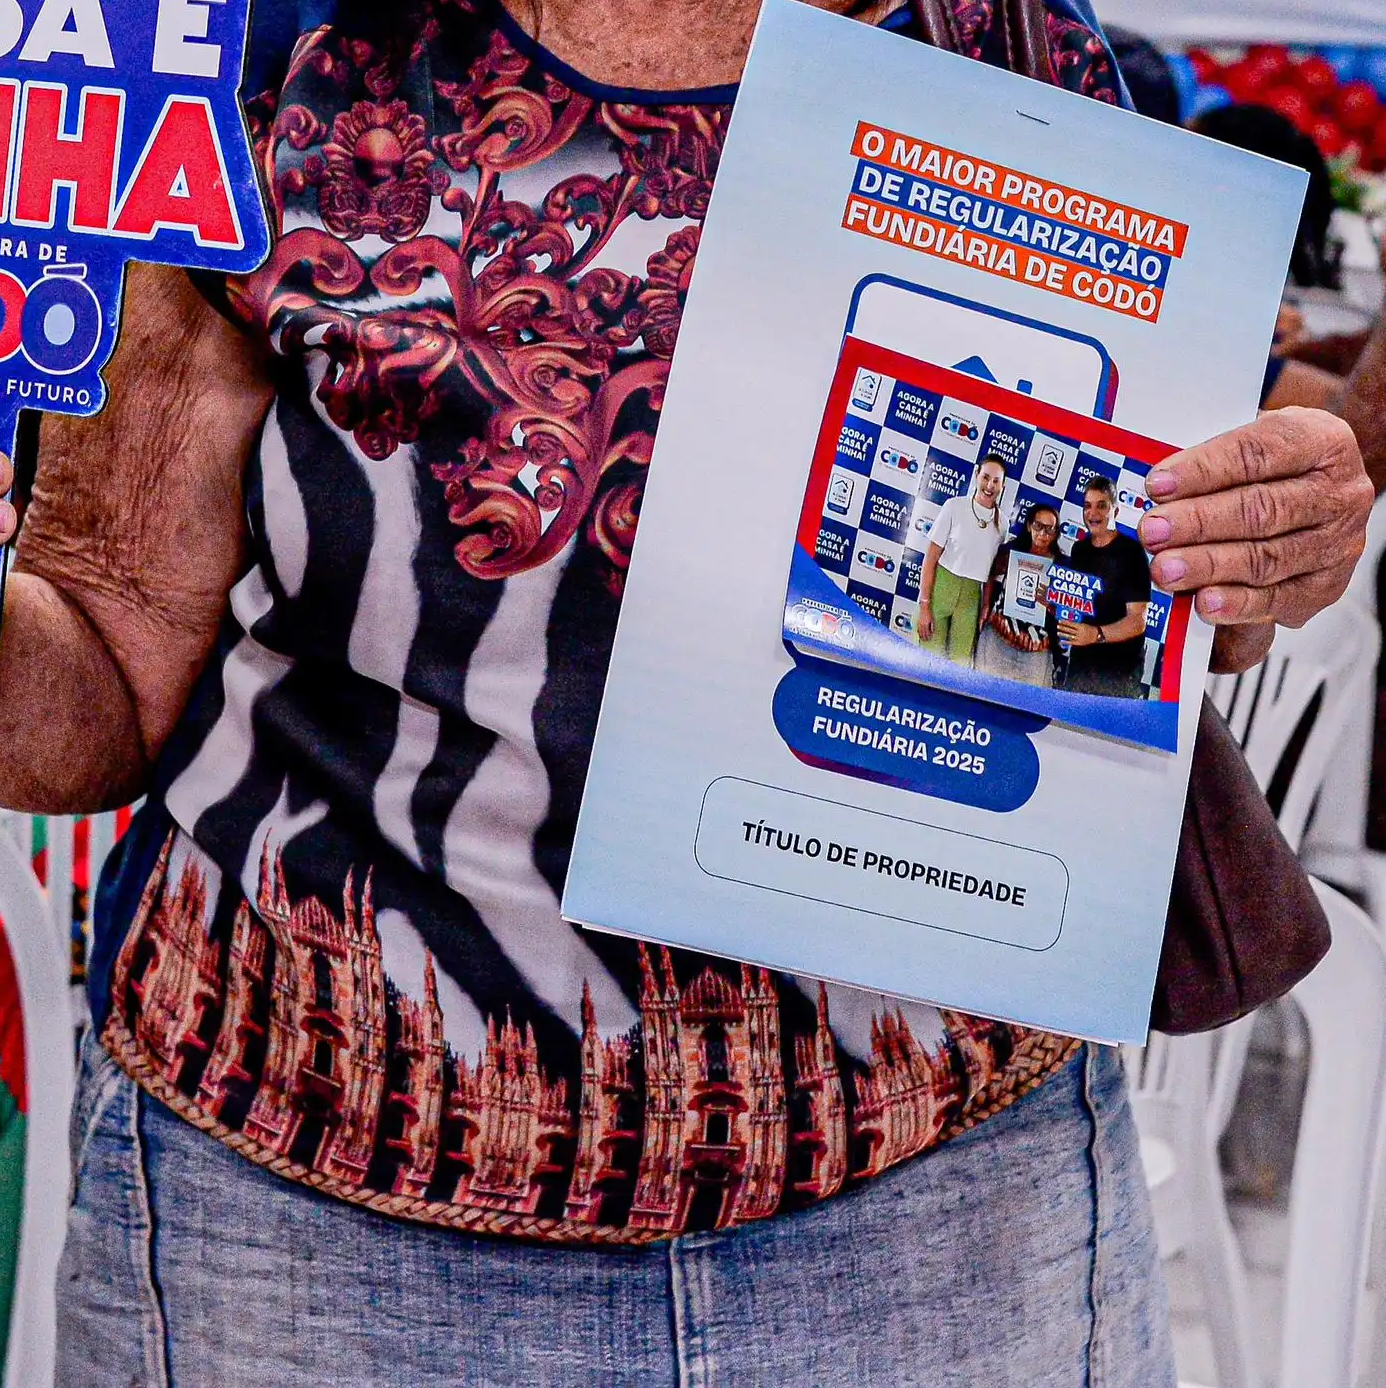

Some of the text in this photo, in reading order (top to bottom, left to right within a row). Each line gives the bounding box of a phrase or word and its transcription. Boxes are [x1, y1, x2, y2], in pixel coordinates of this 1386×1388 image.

[861, 130, 1176, 253] O MAIOR PROGRAMA
[858, 165, 1162, 282] DE REGULARIZAÇÃO
[38, 244, 69, 263] DE
[846, 200, 1158, 317] FUNDIÁRIA DE CODÓ
[897, 391, 934, 411] AGORA A
[899, 401, 921, 416] CASA
[895, 409, 927, 428] MINHA!
[838, 435, 861, 450] CASA
[841, 427, 873, 445] GORA A
[989, 428, 1017, 446] AGORA
[1019, 441, 1025, 449] A
[991, 439, 1014, 454] CASA
[929, 462, 958, 479] AGORA
[931, 472, 953, 487] CASA
[870, 494, 899, 512] AGORA
[873, 505, 895, 520] CASA
[869, 513, 901, 530] MINHA!
[816, 537, 838, 551] CASA
[819, 529, 850, 546] GORA A
[1047, 565, 1089, 588] AGORA
[1092, 579, 1101, 591] A
[1053, 579, 1083, 598] CASA
[850, 593, 879, 608] AGORA
[1046, 587, 1094, 617] MINHA
[816, 686, 991, 747] REGULARIZAÇÃO
[812, 715, 986, 776] FUNDIÁRIA 2025
[742, 819, 1027, 907] TÍTULO DE PROPRIEDADE
